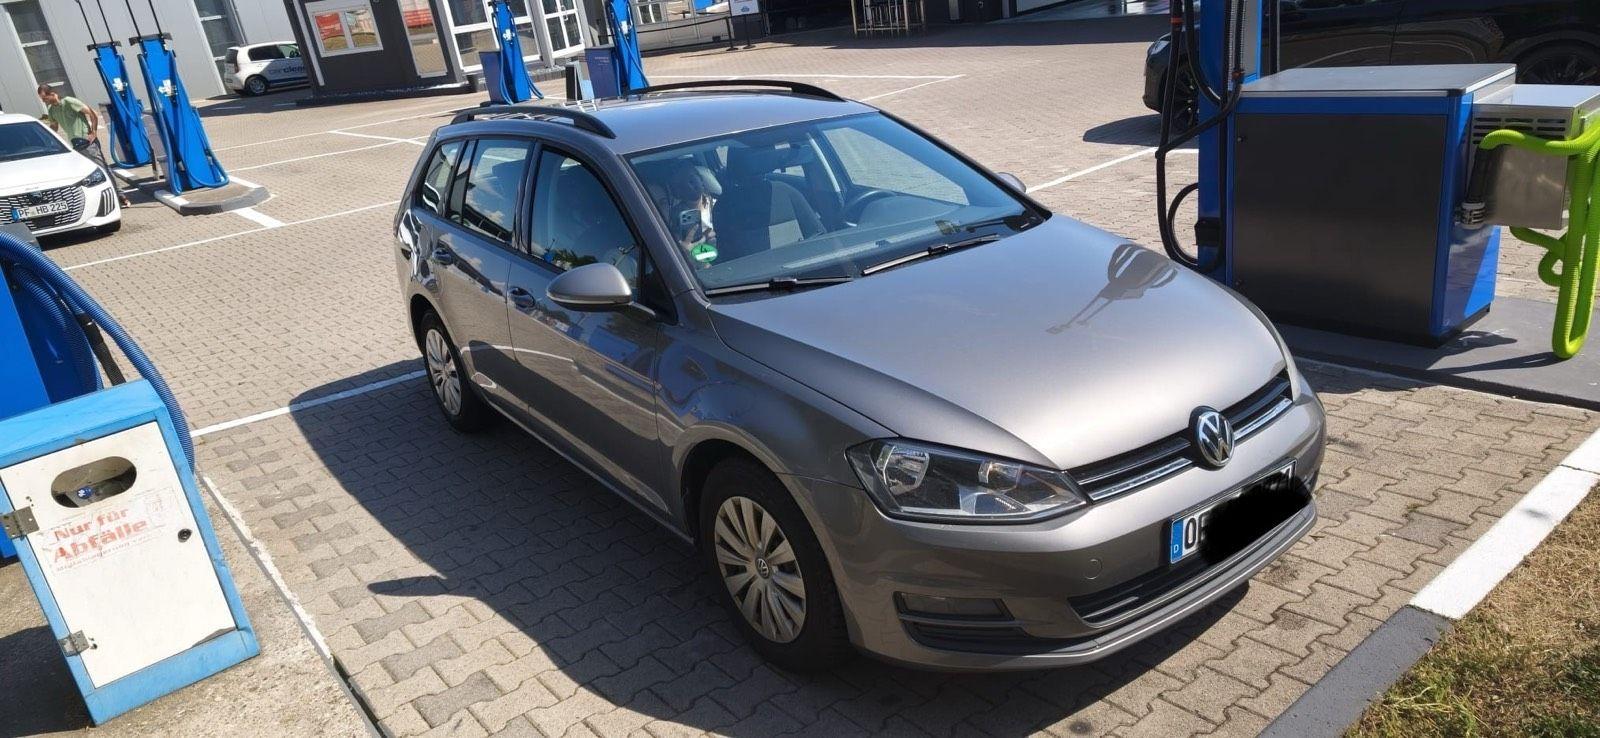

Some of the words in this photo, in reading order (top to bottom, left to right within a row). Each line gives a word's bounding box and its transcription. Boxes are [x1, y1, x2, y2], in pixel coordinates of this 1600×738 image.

[19, 206, 30, 218] PF
[35, 205, 49, 215] HB
[50, 201, 67, 212] 225
[700, 245, 708, 253] 4
[54, 521, 92, 541] Nur
[96, 508, 129, 526] für
[54, 520, 148, 562] Abfälle
